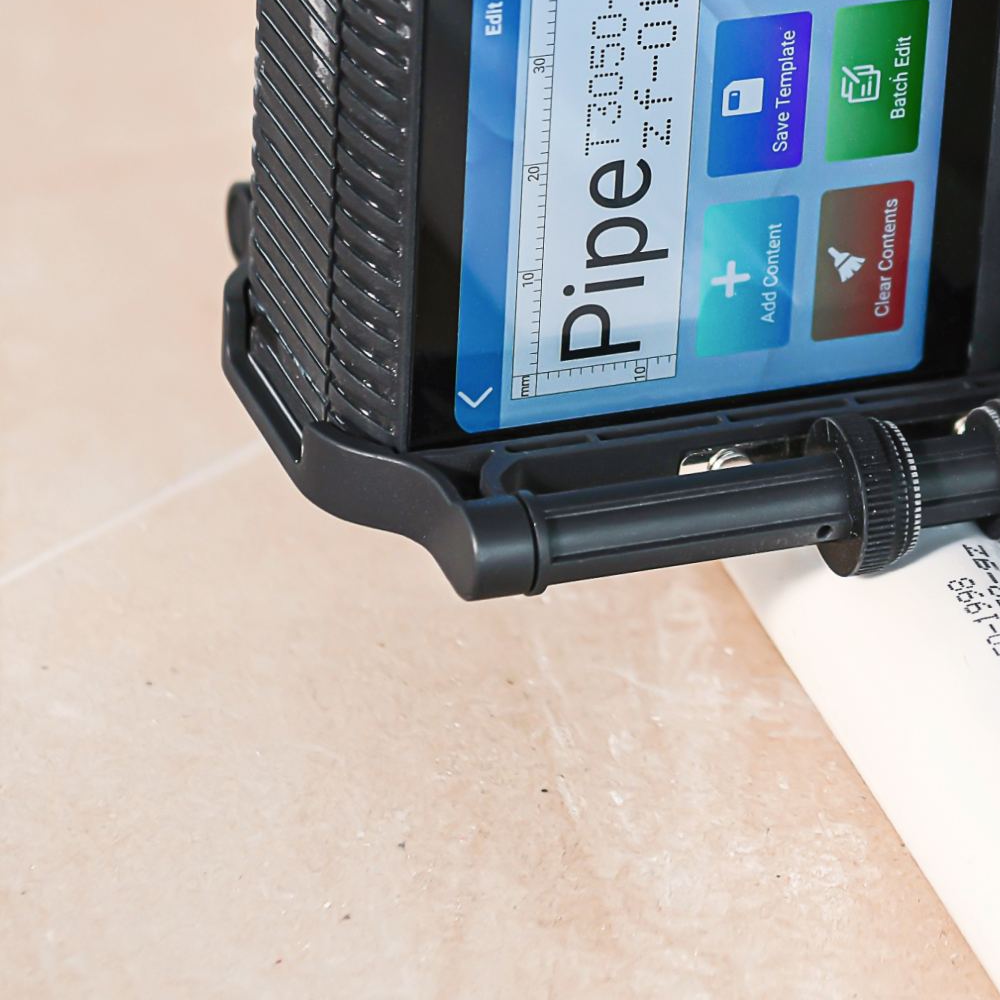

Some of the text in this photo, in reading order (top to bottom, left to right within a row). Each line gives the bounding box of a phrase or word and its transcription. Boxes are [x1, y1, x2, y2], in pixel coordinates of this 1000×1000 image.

[485, 1, 503, 36] Edit
[533, 58, 545, 74] 30
[890, 35, 911, 119] Batch Edit
[772, 30, 797, 152] Save Template
[527, 166, 540, 182] 20
[560, 158, 669, 361] Pipe
[761, 223, 782, 323] Add Content
[874, 198, 898, 317] Clear Contents
[522, 272, 535, 287] 10
[520, 375, 530, 397] mm
[634, 366, 646, 381] 10
